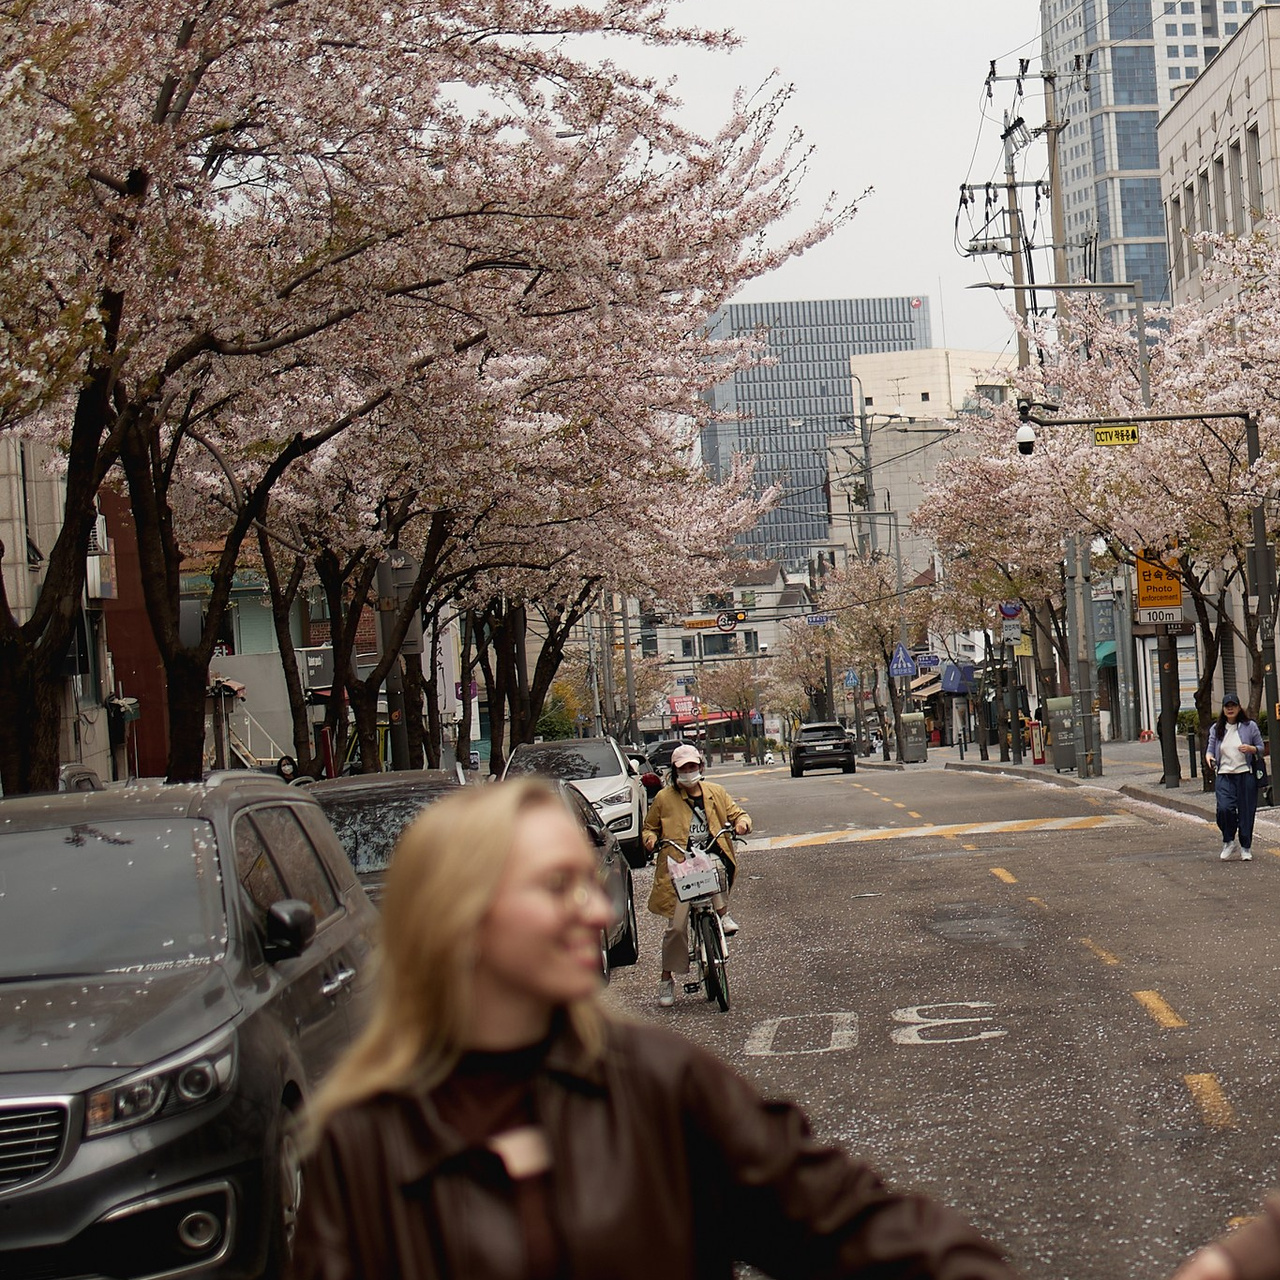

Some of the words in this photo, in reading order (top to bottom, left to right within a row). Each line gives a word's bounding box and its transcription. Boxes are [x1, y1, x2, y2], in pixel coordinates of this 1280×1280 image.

[1095, 430, 1113, 442] CCTV
[1114, 429, 1130, 441] 작동중
[1146, 584, 1173, 593] Photo
[1141, 594, 1179, 602] enforcement
[1147, 610, 1175, 621] 100m
